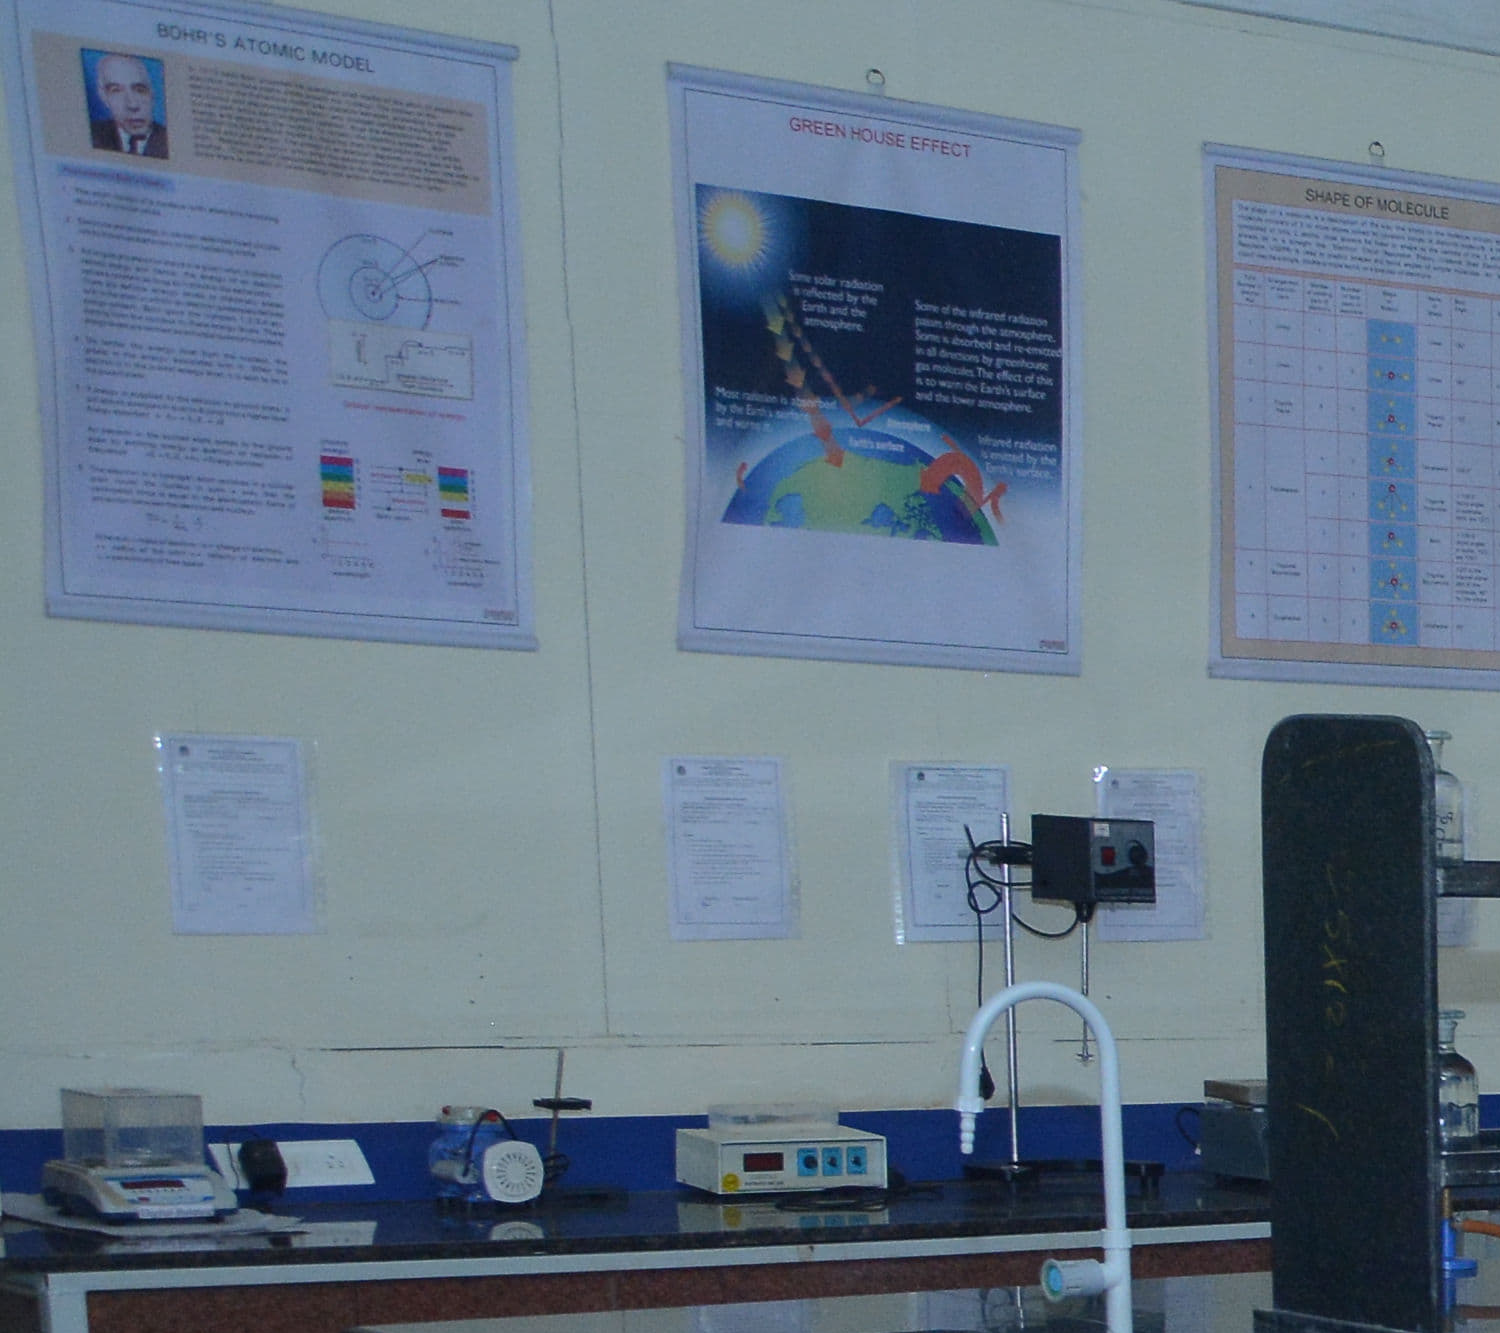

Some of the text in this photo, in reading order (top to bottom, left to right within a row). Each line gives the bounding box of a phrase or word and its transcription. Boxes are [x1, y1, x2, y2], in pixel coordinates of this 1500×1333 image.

[156, 23, 375, 73] BOHR'S ATOMIC MODEL
[789, 116, 971, 157] GREEN HOUSE EFFECT
[1305, 188, 1449, 220] SHAPE OF MOLECULE
[840, 279, 884, 292] radiation
[802, 300, 867, 317] Earth and the
[846, 292, 858, 305] by
[861, 294, 877, 306] the
[915, 299, 1048, 326] Some of the infrared radiation
[944, 321, 979, 335] through
[981, 325, 997, 336] the
[915, 329, 940, 343] Some
[951, 336, 992, 350] absorbed
[994, 342, 1011, 352] and
[915, 346, 925, 355] in
[927, 347, 937, 356] all
[982, 354, 993, 366] by
[995, 358, 1048, 371] greenhouse
[916, 363, 930, 373] gas
[977, 366, 994, 379] The
[996, 371, 1022, 383] effect
[1025, 374, 1034, 384] of
[1036, 376, 1053, 386] this
[915, 391, 933, 401] and
[935, 392, 950, 402] the
[925, 378, 936, 387] to
[980, 382, 1011, 396] Earth's
[1013, 388, 1047, 400] surface
[1026, 453, 1037, 469] by
